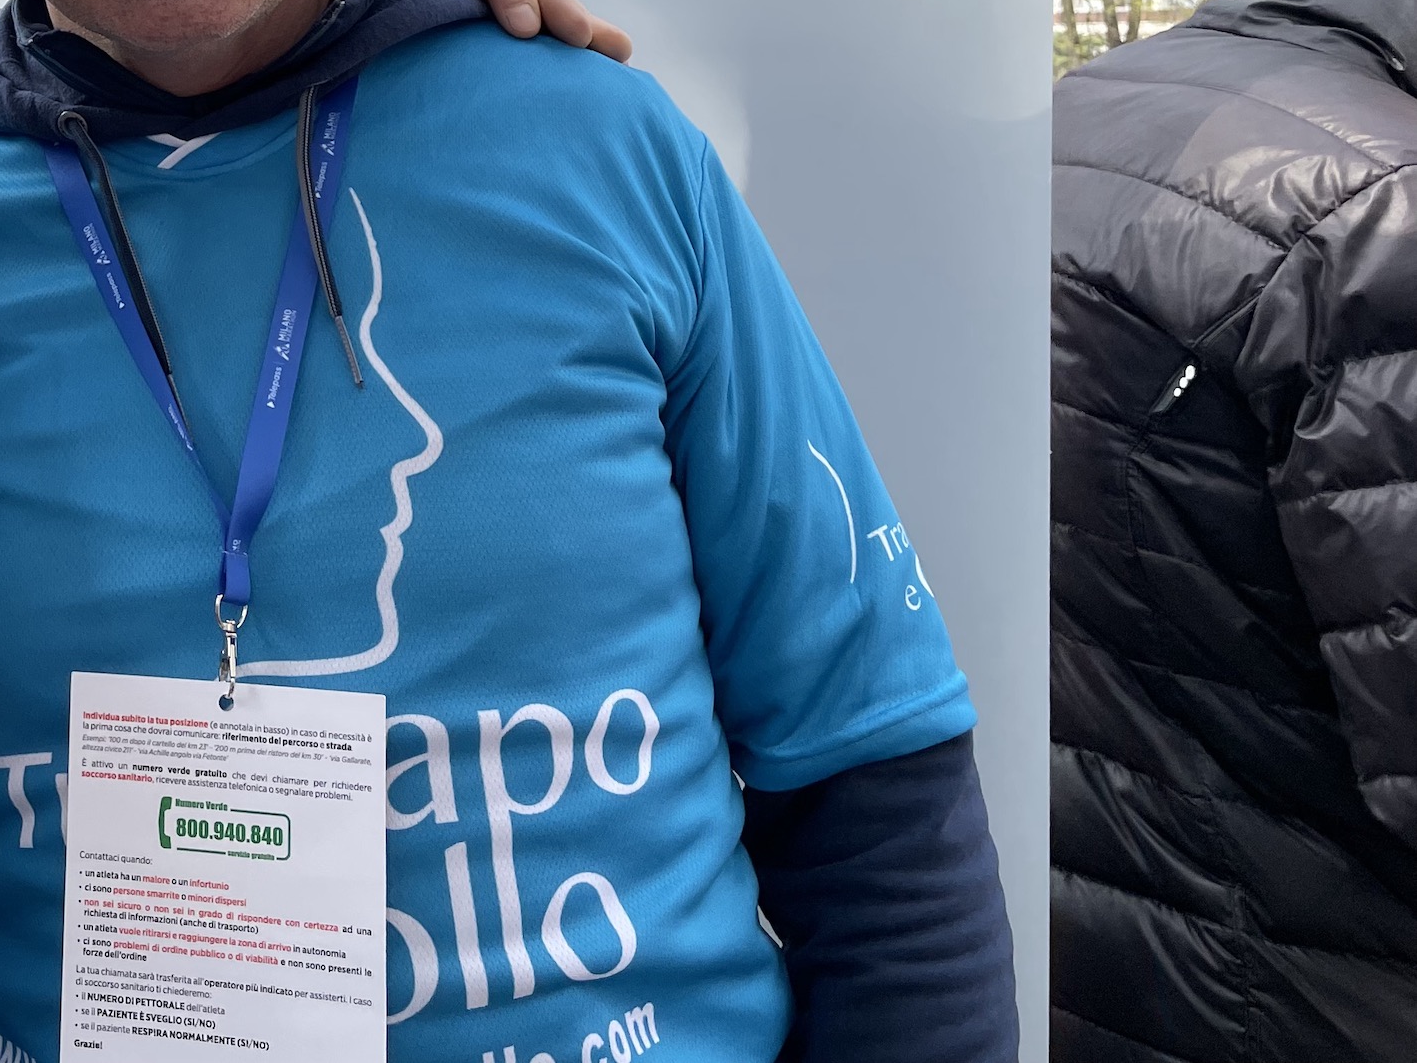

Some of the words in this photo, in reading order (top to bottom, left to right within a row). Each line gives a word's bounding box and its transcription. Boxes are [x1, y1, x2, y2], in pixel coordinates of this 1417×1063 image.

[83, 226, 99, 255] MILANO
[268, 366, 282, 401] Telepass
[278, 309, 292, 341] MILANO
[83, 711, 120, 722] Individua
[121, 714, 146, 724] subito
[155, 717, 169, 725] tua
[169, 718, 209, 729] posizione
[219, 723, 254, 732] annotala
[263, 725, 290, 737] basso)
[299, 729, 318, 738] caso
[90, 723, 113, 732] prima
[114, 725, 132, 733] cosa
[132, 725, 147, 734] che
[147, 726, 173, 736] dovrai
[222, 732, 268, 744] riferimento
[268, 736, 282, 745] del
[282, 739, 319, 748] percorso
[81, 771, 117, 780] soccorso
[155, 777, 187, 786] ricevere
[187, 779, 228, 789] assistenza
[228, 782, 268, 793] telefonica
[275, 787, 314, 798] segnalare
[91, 760, 114, 769] attivo
[132, 764, 163, 773] numero
[167, 766, 191, 775] verde
[195, 769, 227, 778] gratuito
[231, 771, 246, 781] che
[250, 773, 268, 782] devi
[271, 775, 309, 786] chiamare
[313, 780, 327, 788] per
[331, 781, 372, 792] richiedere
[176, 818, 283, 846] 800.940.840
[79, 850, 120, 862] Contattaci
[96, 870, 119, 880] atleta
[142, 875, 171, 885] malore
[189, 879, 229, 891] infortunio
[92, 885, 112, 894] sono
[113, 887, 145, 897] persone
[146, 890, 180, 900] smarrite
[187, 894, 214, 903] minori
[214, 896, 247, 907] dispersi
[83, 908, 118, 919] richiesta
[128, 912, 178, 925] informazioni
[179, 917, 207, 928] (anche
[217, 922, 259, 935] trasporto)
[84, 899, 100, 907] non
[102, 900, 114, 908] sei
[117, 901, 142, 911] sicuro
[153, 905, 170, 914] non
[172, 907, 184, 915] sei
[198, 910, 223, 919] grado
[237, 913, 282, 926] rispondere
[285, 920, 300, 928] con
[303, 922, 339, 932] certezza
[356, 928, 372, 936] una
[83, 947, 103, 958] forze
[94, 924, 118, 934] atleta
[119, 927, 141, 936] vuole
[142, 928, 171, 939] ritirarsi
[178, 933, 228, 945] raggiungere
[237, 940, 257, 948] zona
[267, 943, 292, 952] arrivo
[302, 947, 346, 959] autonomia
[92, 939, 112, 947] sono
[113, 941, 150, 951] problemi
[161, 946, 188, 955] ordine
[190, 948, 226, 959] pubblico
[288, 960, 304, 968] non
[305, 962, 326, 971] sono
[328, 965, 362, 976] presenti
[84, 979, 120, 989] soccorso
[120, 983, 155, 993] sanitario
[87, 966, 100, 975] tua
[100, 967, 137, 979] chiamata
[156, 973, 192, 985] trasferita
[260, 984, 293, 996] indicato
[294, 990, 308, 998] per
[353, 998, 373, 1007] caso
[87, 992, 124, 1004] NUMERO
[135, 997, 185, 1011] PETTORALE
[97, 1008, 138, 1020] PAZIENTE
[145, 1013, 183, 1025] SVEGLIO
[96, 1024, 131, 1034] paziente
[132, 1026, 168, 1038] RESPIRA
[169, 1030, 236, 1046] NORMALMENTE
